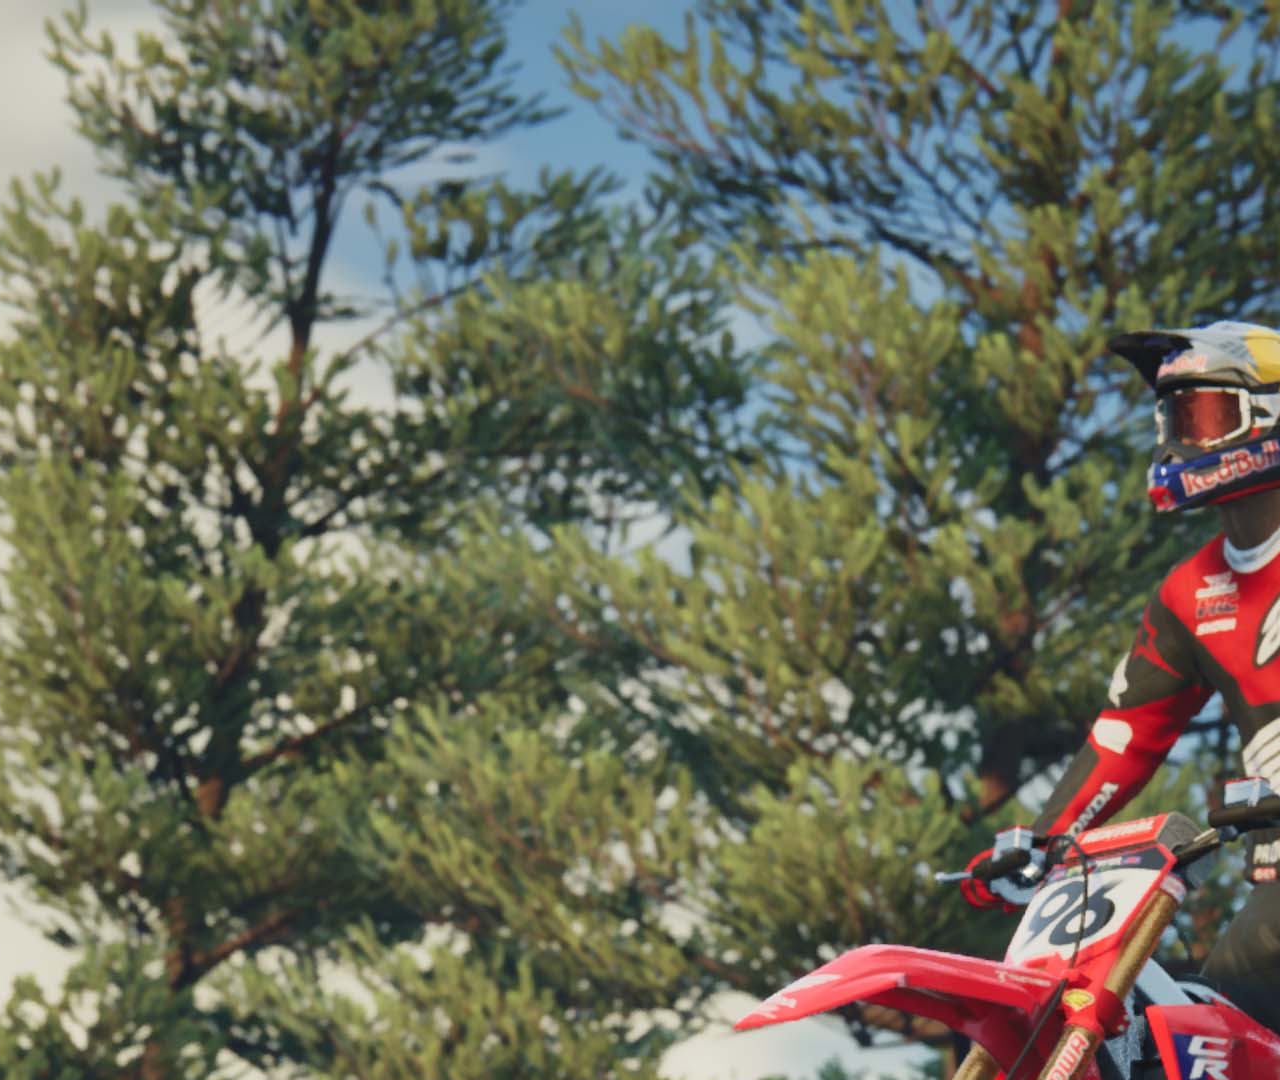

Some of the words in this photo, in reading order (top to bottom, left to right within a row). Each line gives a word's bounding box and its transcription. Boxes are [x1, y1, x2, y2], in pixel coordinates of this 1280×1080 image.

[1180, 453, 1235, 498] Red
[1233, 439, 1280, 477] Bull
[1027, 879, 1122, 946] 96
